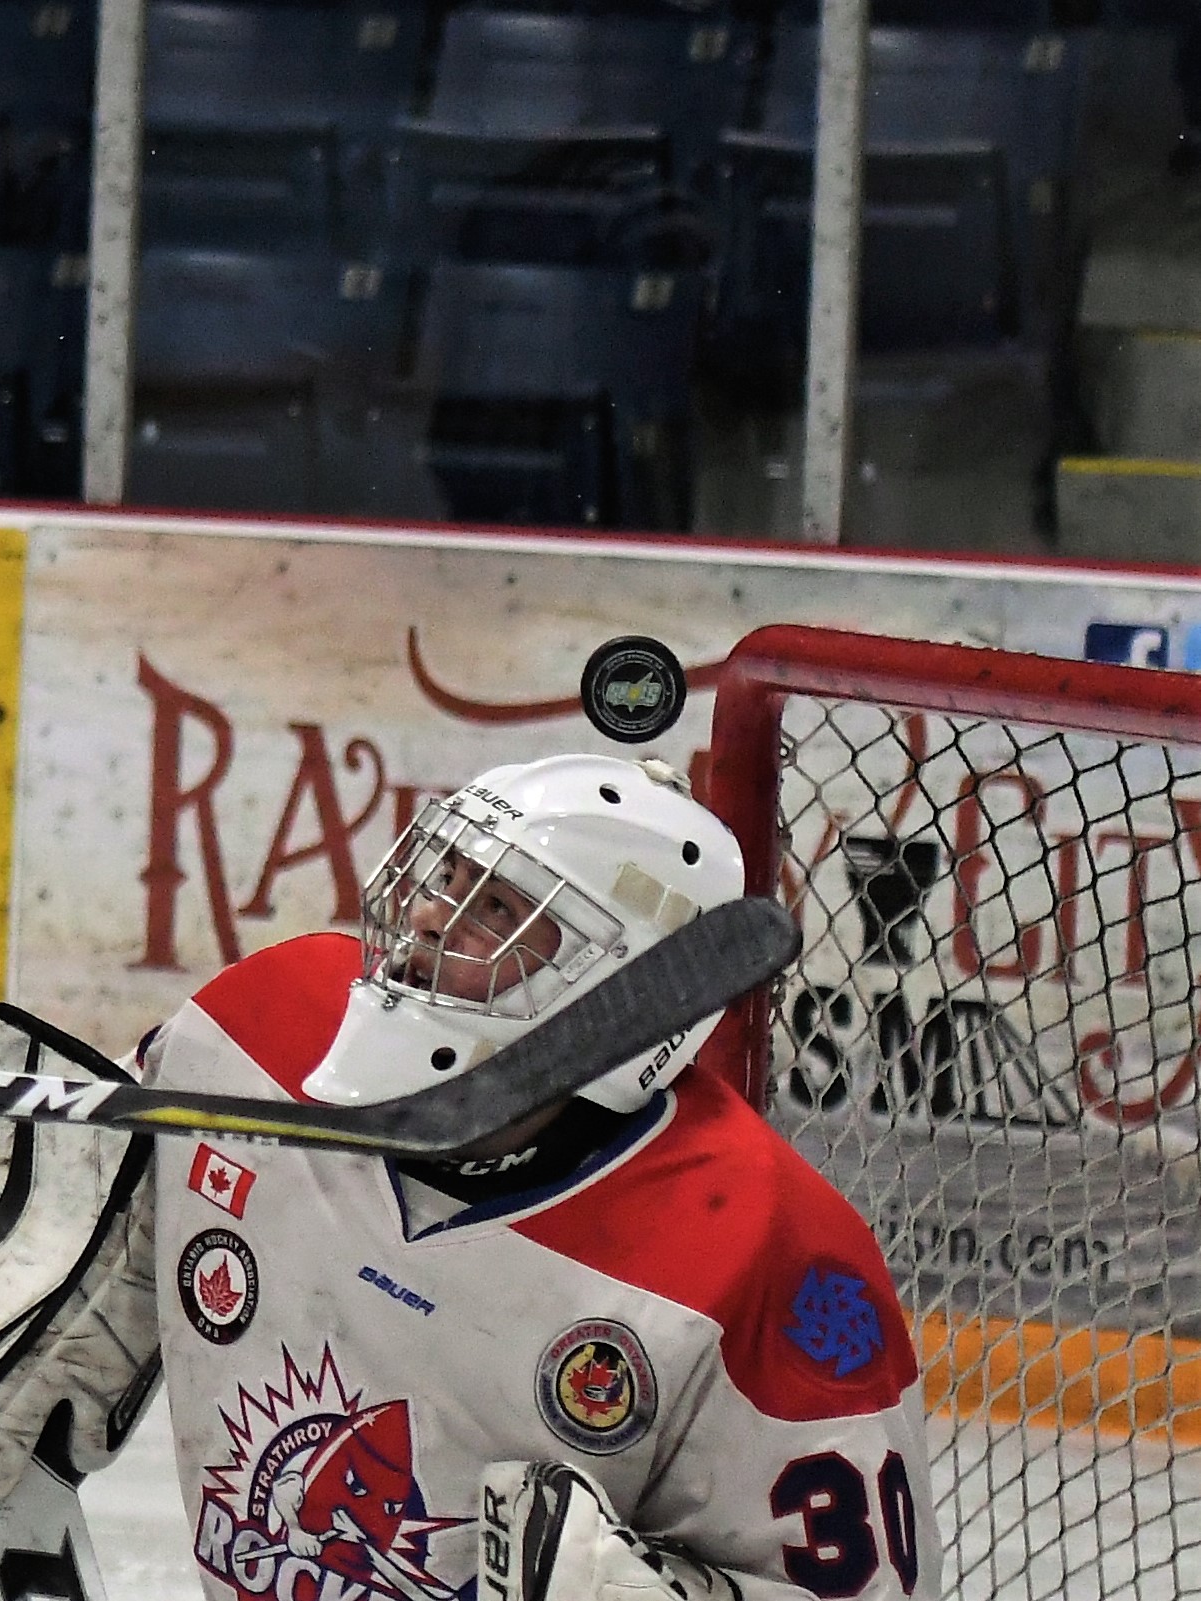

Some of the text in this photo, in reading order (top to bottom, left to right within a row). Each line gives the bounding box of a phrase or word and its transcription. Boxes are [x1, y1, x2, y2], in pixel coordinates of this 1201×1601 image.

[442, 1146, 538, 1176] CM
[357, 1266, 436, 1317] BAUER
[251, 1421, 333, 1518] STRATHROY
[770, 1450, 920, 1600] 30
